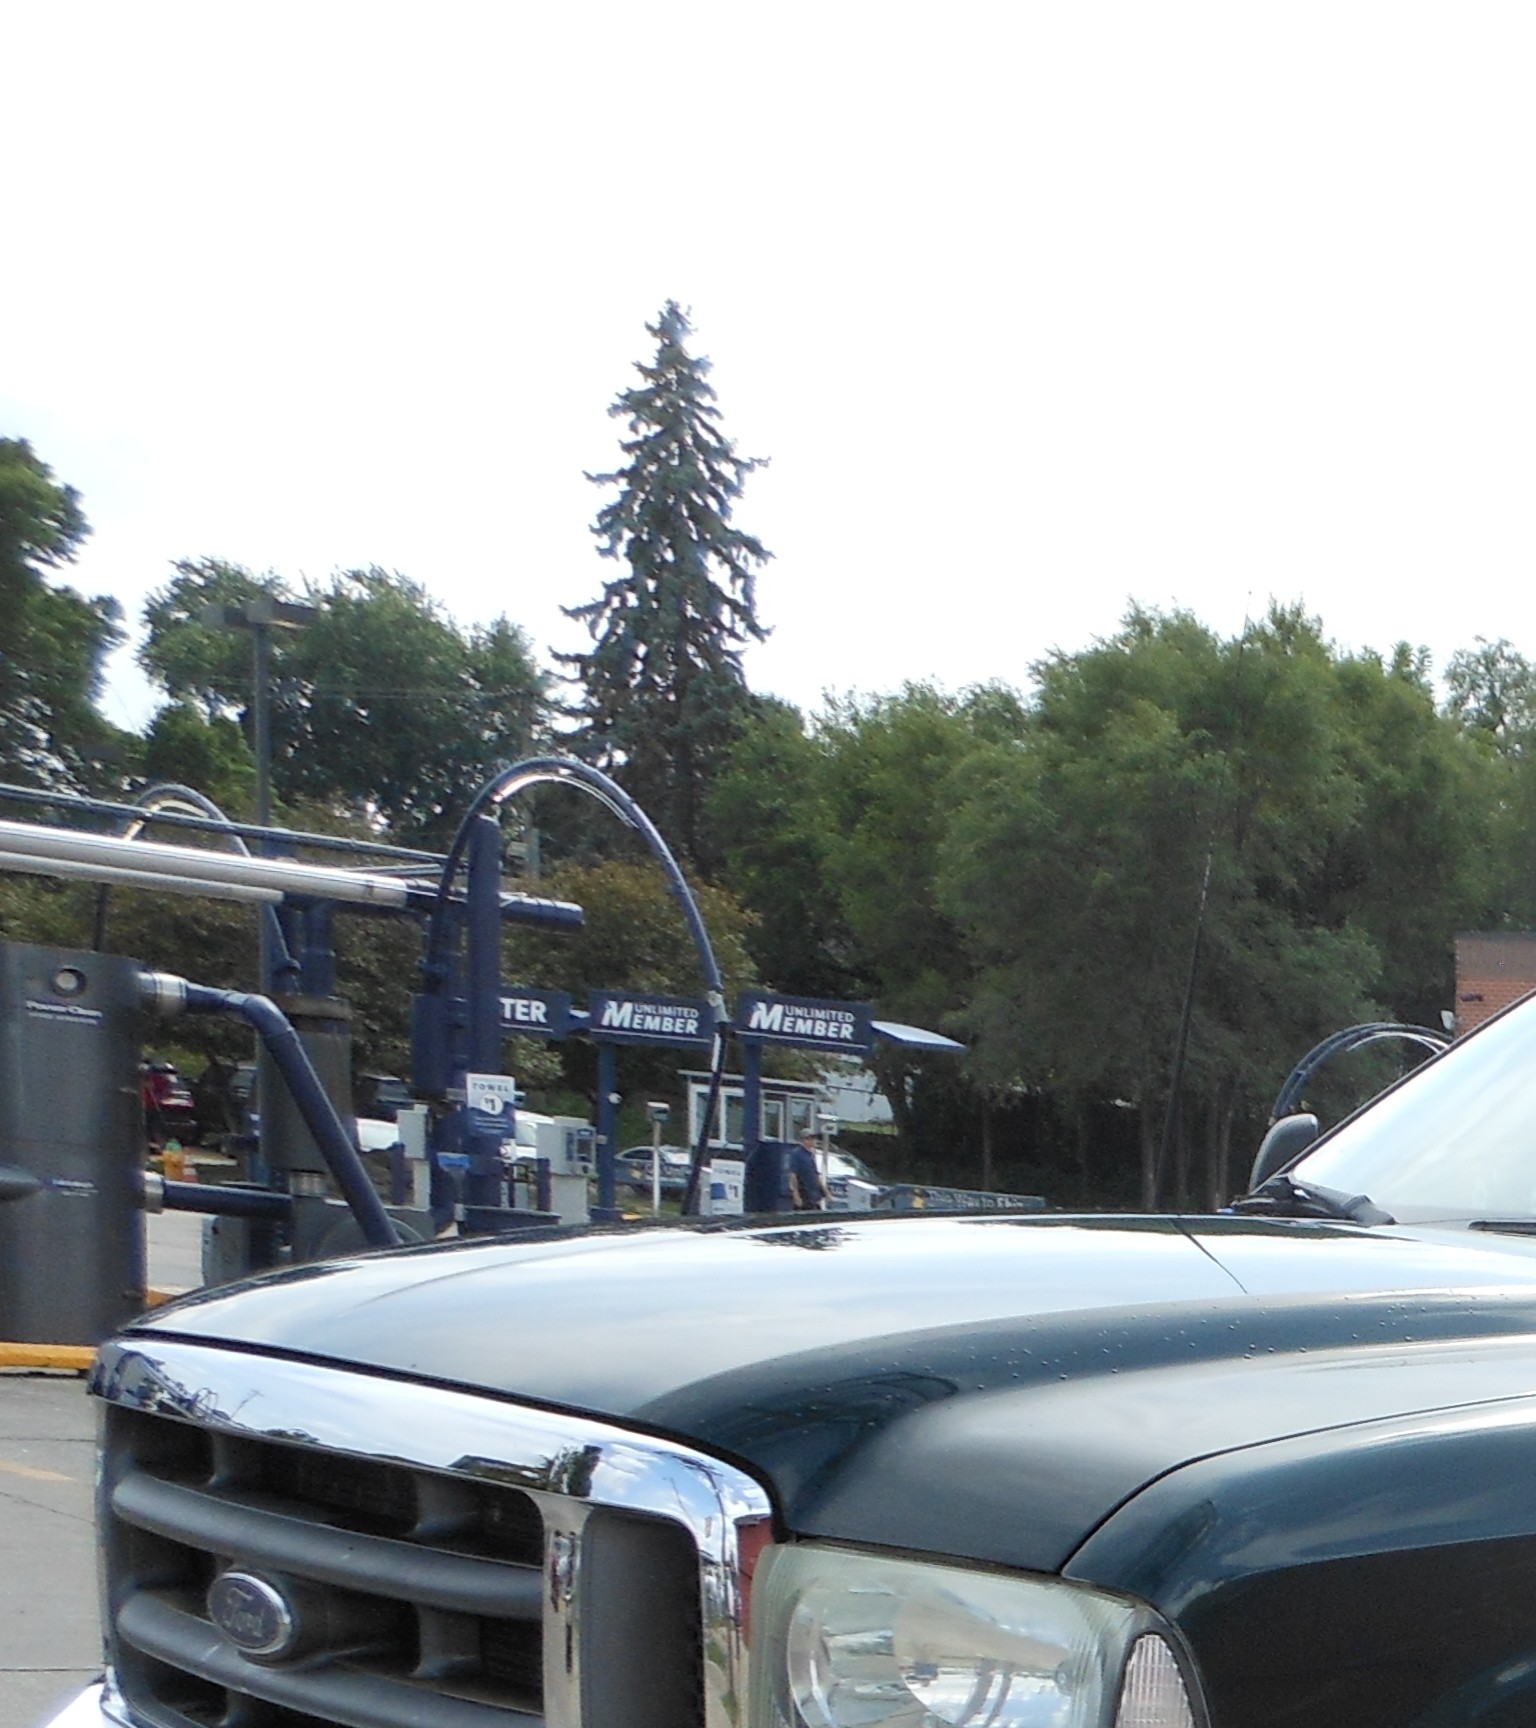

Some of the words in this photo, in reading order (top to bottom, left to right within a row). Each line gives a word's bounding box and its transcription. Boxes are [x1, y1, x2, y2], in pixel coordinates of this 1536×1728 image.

[600, 1000, 699, 1035] MEMBER
[634, 1002, 700, 1019] UNLIMITED
[748, 1001, 855, 1041] MEMBER
[784, 1004, 855, 1023] UNLIMITED
